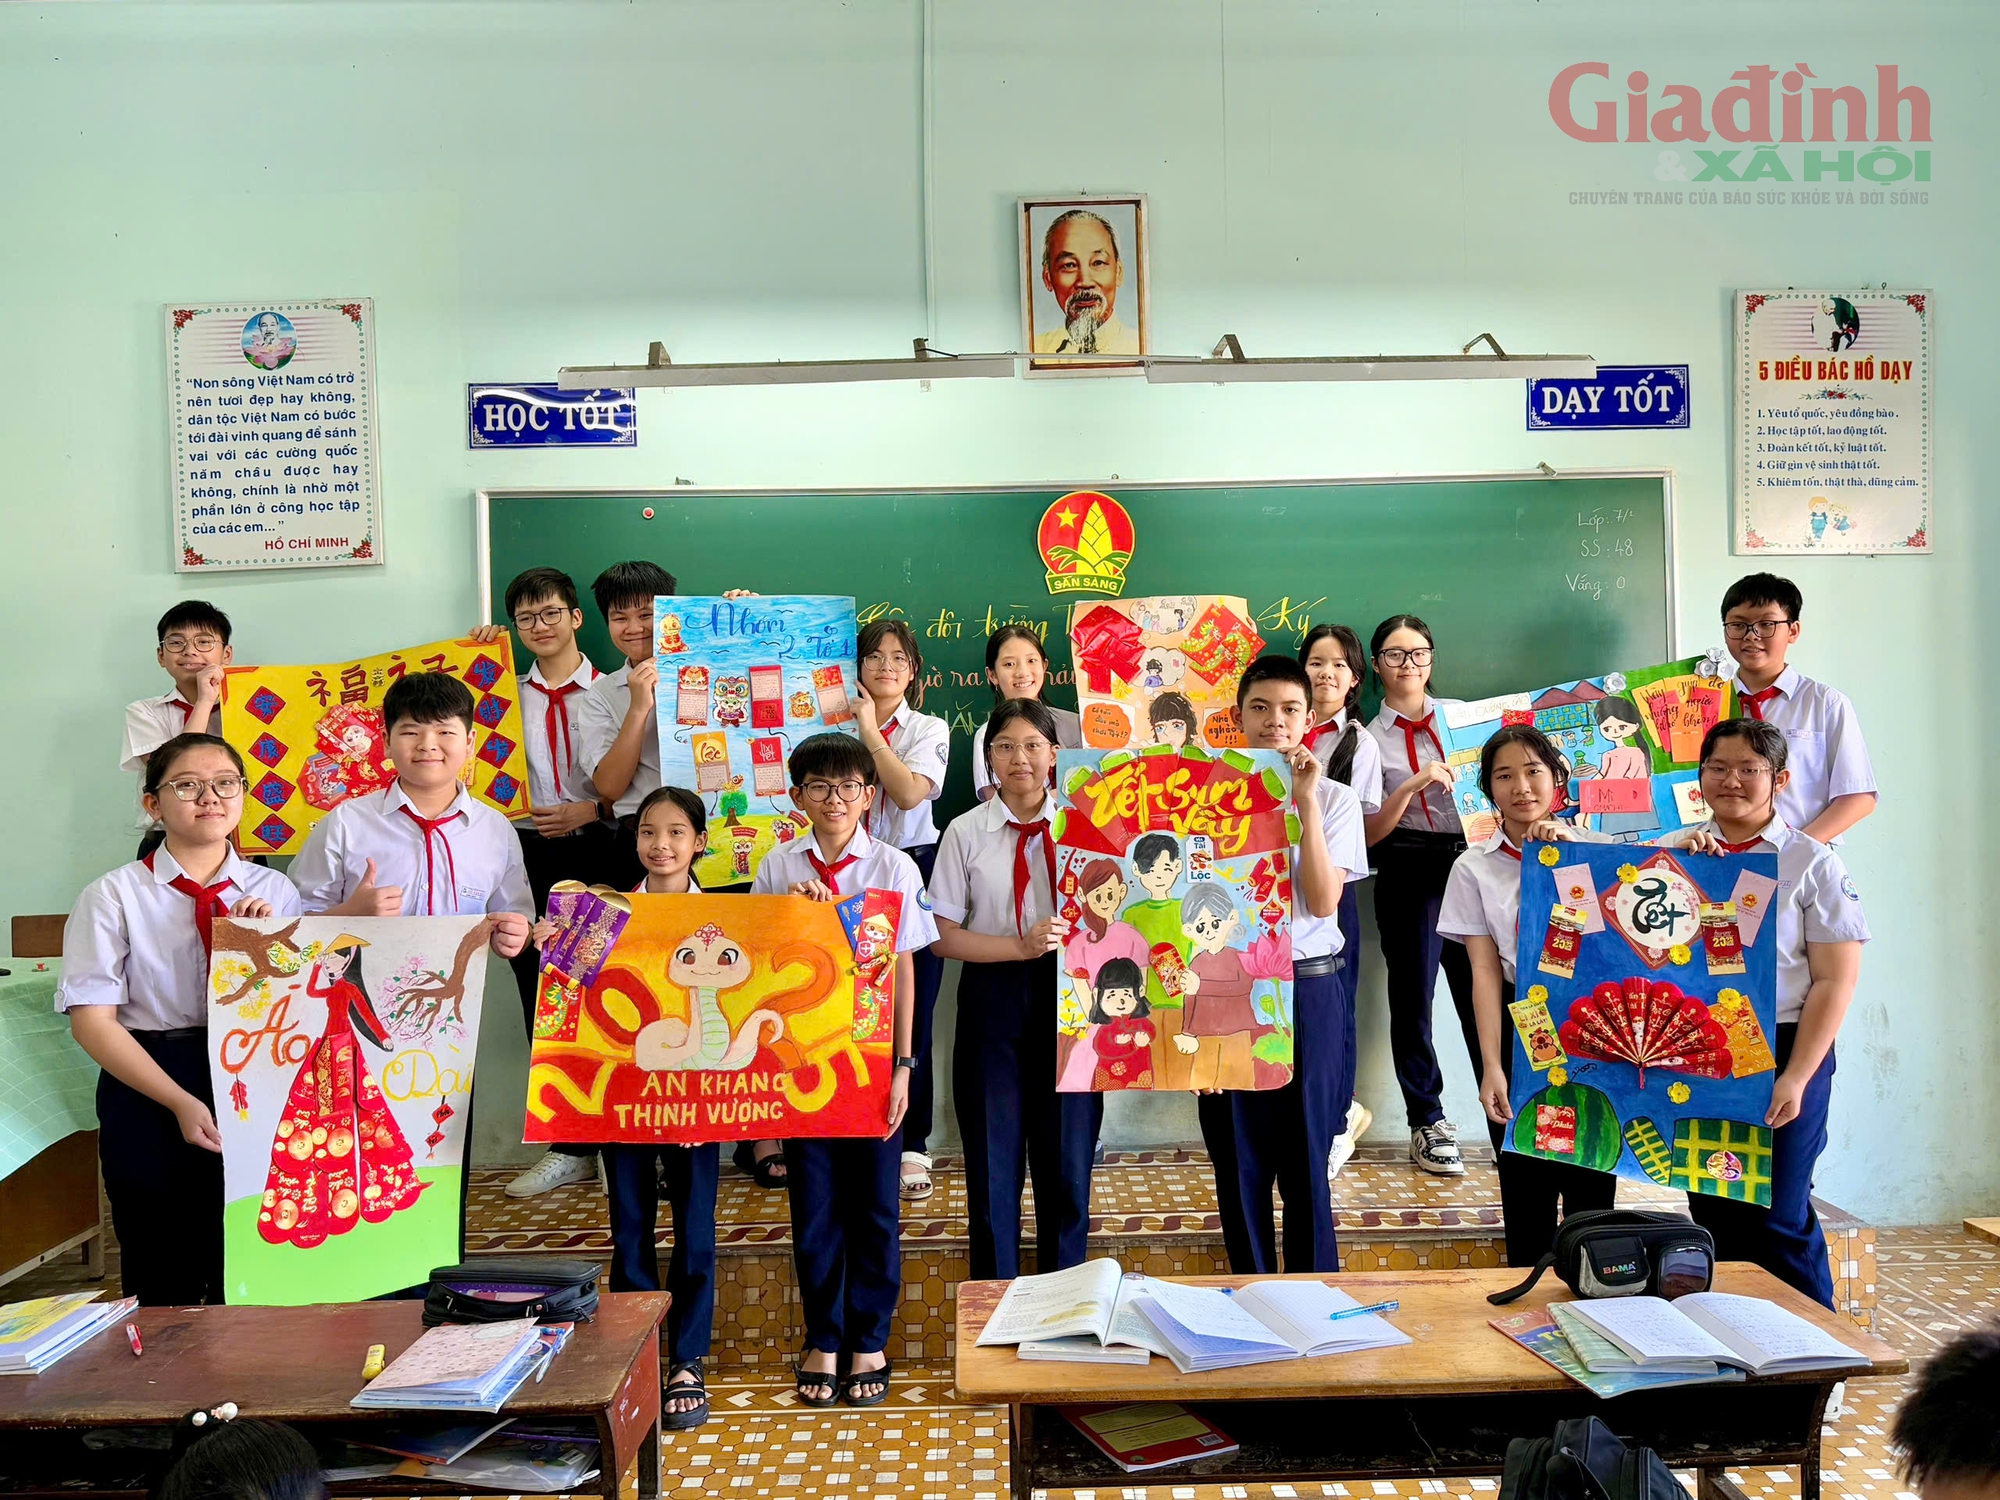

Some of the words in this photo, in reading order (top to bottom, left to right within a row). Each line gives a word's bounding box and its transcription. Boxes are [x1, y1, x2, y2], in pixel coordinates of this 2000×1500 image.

[1759, 361, 1768, 380] 5
[1775, 355, 1811, 380] ĐIỀU
[1817, 357, 1848, 380] BÁC
[1854, 355, 1873, 380] HỒ
[1881, 361, 1912, 384] DẠY
[222, 376, 254, 389] sông
[258, 375, 283, 387] Việt
[286, 374, 314, 386] Nam
[318, 373, 333, 384] có
[336, 371, 355, 384] trở
[187, 396, 211, 407] nên
[219, 395, 242, 406] tươi
[250, 394, 273, 406] đẹp
[281, 393, 303, 406] hay
[310, 392, 355, 404] không,
[1542, 387, 1604, 419] DẠY
[1614, 372, 1673, 412] TỐT
[188, 414, 212, 425] dân
[217, 413, 237, 426] tộc
[241, 412, 266, 424] Việt
[271, 411, 299, 422] Nam
[304, 410, 320, 421] có
[324, 409, 356, 420] bước
[483, 404, 549, 438] HỌC
[559, 389, 621, 430] TỐT
[1757, 409, 1765, 418] 1.
[1767, 408, 1788, 418] Yêu
[1790, 407, 1800, 418] tổ
[1801, 407, 1828, 419] quốc,
[1830, 409, 1848, 419] yêu
[1850, 408, 1874, 419] đồng
[188, 431, 205, 444] tới
[208, 431, 228, 443] đài
[232, 430, 259, 442] vinh
[262, 430, 302, 443] quang
[306, 426, 322, 439] để
[325, 426, 356, 439] sánh
[1757, 426, 1765, 435] 2.
[1767, 426, 1788, 436] Học
[1790, 425, 1806, 437] tập
[1808, 425, 1825, 436] tốt,
[1827, 426, 1842, 435] lao
[1843, 426, 1868, 437] động
[1870, 424, 1886, 435] tốt.
[189, 450, 208, 462] vai
[217, 450, 236, 460] với
[245, 448, 268, 460] các
[276, 446, 317, 460] cường
[325, 444, 357, 458] quốc
[1757, 443, 1765, 452] 3.
[1767, 443, 1794, 452] Đoàn
[1796, 442, 1812, 452] kết
[1814, 442, 1832, 454] tốt,
[1834, 443, 1846, 454] kỷ
[1848, 443, 1867, 453] luật
[1869, 442, 1886, 452] tốt.
[190, 468, 221, 480] năm
[235, 466, 271, 478] châu
[284, 465, 320, 477] được
[333, 464, 358, 477] hay
[1757, 460, 1765, 470] 4.
[1767, 460, 1786, 470] Giữ
[1788, 460, 1803, 472] gìn
[1805, 461, 1816, 471] vệ
[1818, 460, 1838, 470] sinh
[1840, 460, 1860, 471] thật
[1863, 459, 1880, 470] tốt.
[191, 486, 236, 499] không,
[242, 484, 278, 496] chính
[286, 483, 296, 494] là
[303, 482, 328, 493] nhờ
[334, 481, 359, 493] một
[1757, 478, 1765, 487] 5.
[1767, 477, 1800, 487] Khiêm
[1803, 476, 1822, 488] tốn,
[1825, 477, 1844, 488] thật
[1847, 477, 1866, 488] thà,
[1868, 477, 1893, 488] dũng
[1895, 476, 1919, 487] cảm.
[192, 504, 224, 518] phần
[231, 503, 251, 515] lớn
[257, 502, 264, 514] ở
[271, 502, 303, 515] công
[309, 500, 334, 513] học
[339, 499, 360, 512] tập
[193, 522, 216, 534] của
[219, 522, 241, 533] các
[265, 537, 285, 550] HỒ
[288, 537, 310, 549] CHÍ
[316, 538, 348, 548] MINH
[1615, 538, 1633, 556] 48
[1083, 577, 1118, 590] SÀNG
[1257, 596, 1326, 650] Ký
[779, 634, 801, 660] 2
[839, 637, 854, 656] 1
[950, 670, 984, 687] ra
[1084, 762, 1163, 833] Tết
[641, 1071, 687, 1097] AN
[701, 1069, 789, 1095] KHANG
[614, 1102, 697, 1135] THỊNH
[707, 1099, 784, 1131] VƯỢNG
[1603, 1263, 1636, 1274] BAMA
